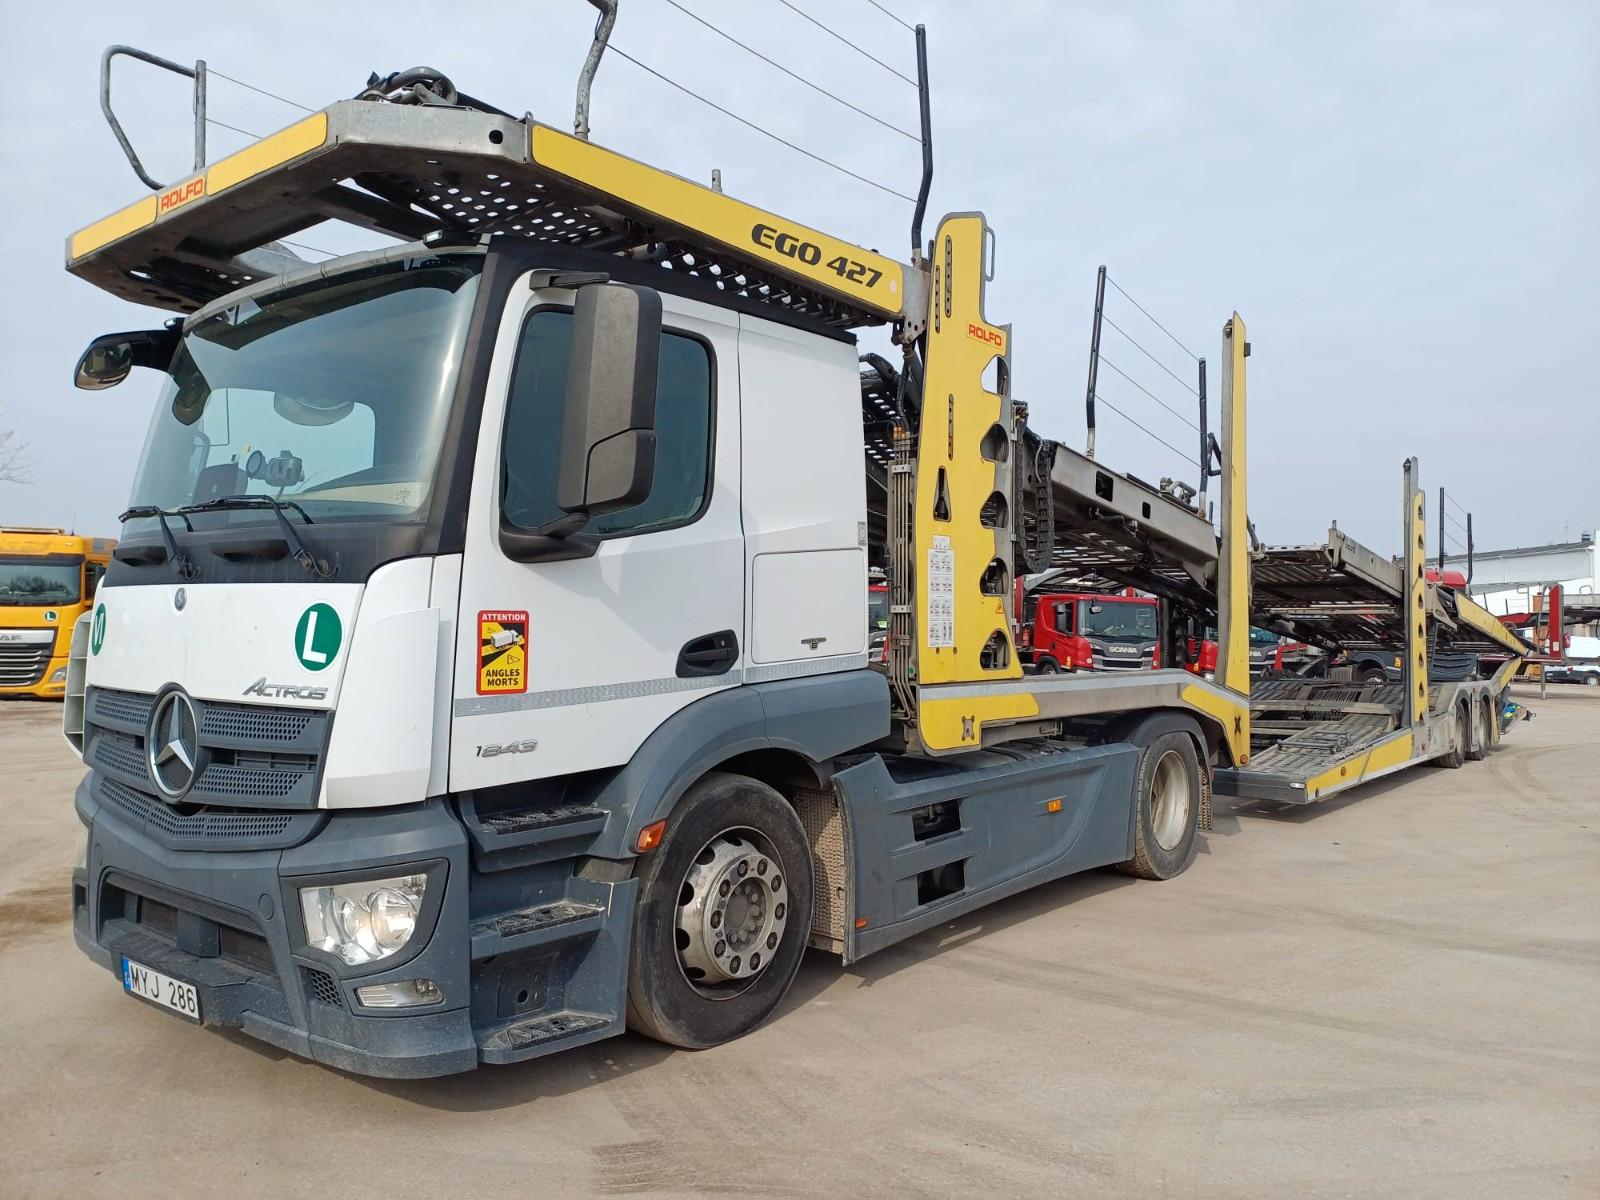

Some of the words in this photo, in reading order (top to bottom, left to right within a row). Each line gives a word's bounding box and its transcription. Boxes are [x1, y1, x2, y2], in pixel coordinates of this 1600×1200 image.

[160, 178, 204, 211] ROLFO
[751, 223, 822, 266] EGO
[826, 256, 883, 288] 427
[968, 323, 1002, 347] ROLFO
[481, 613, 526, 621] ATTENTION
[302, 610, 327, 664] L
[1108, 646, 1138, 654] SCANIA
[485, 668, 521, 678] ANGLES
[487, 677, 519, 687] MORTS
[476, 739, 538, 758] 1843
[130, 965, 160, 998] MYJ
[168, 981, 196, 1013] 286
